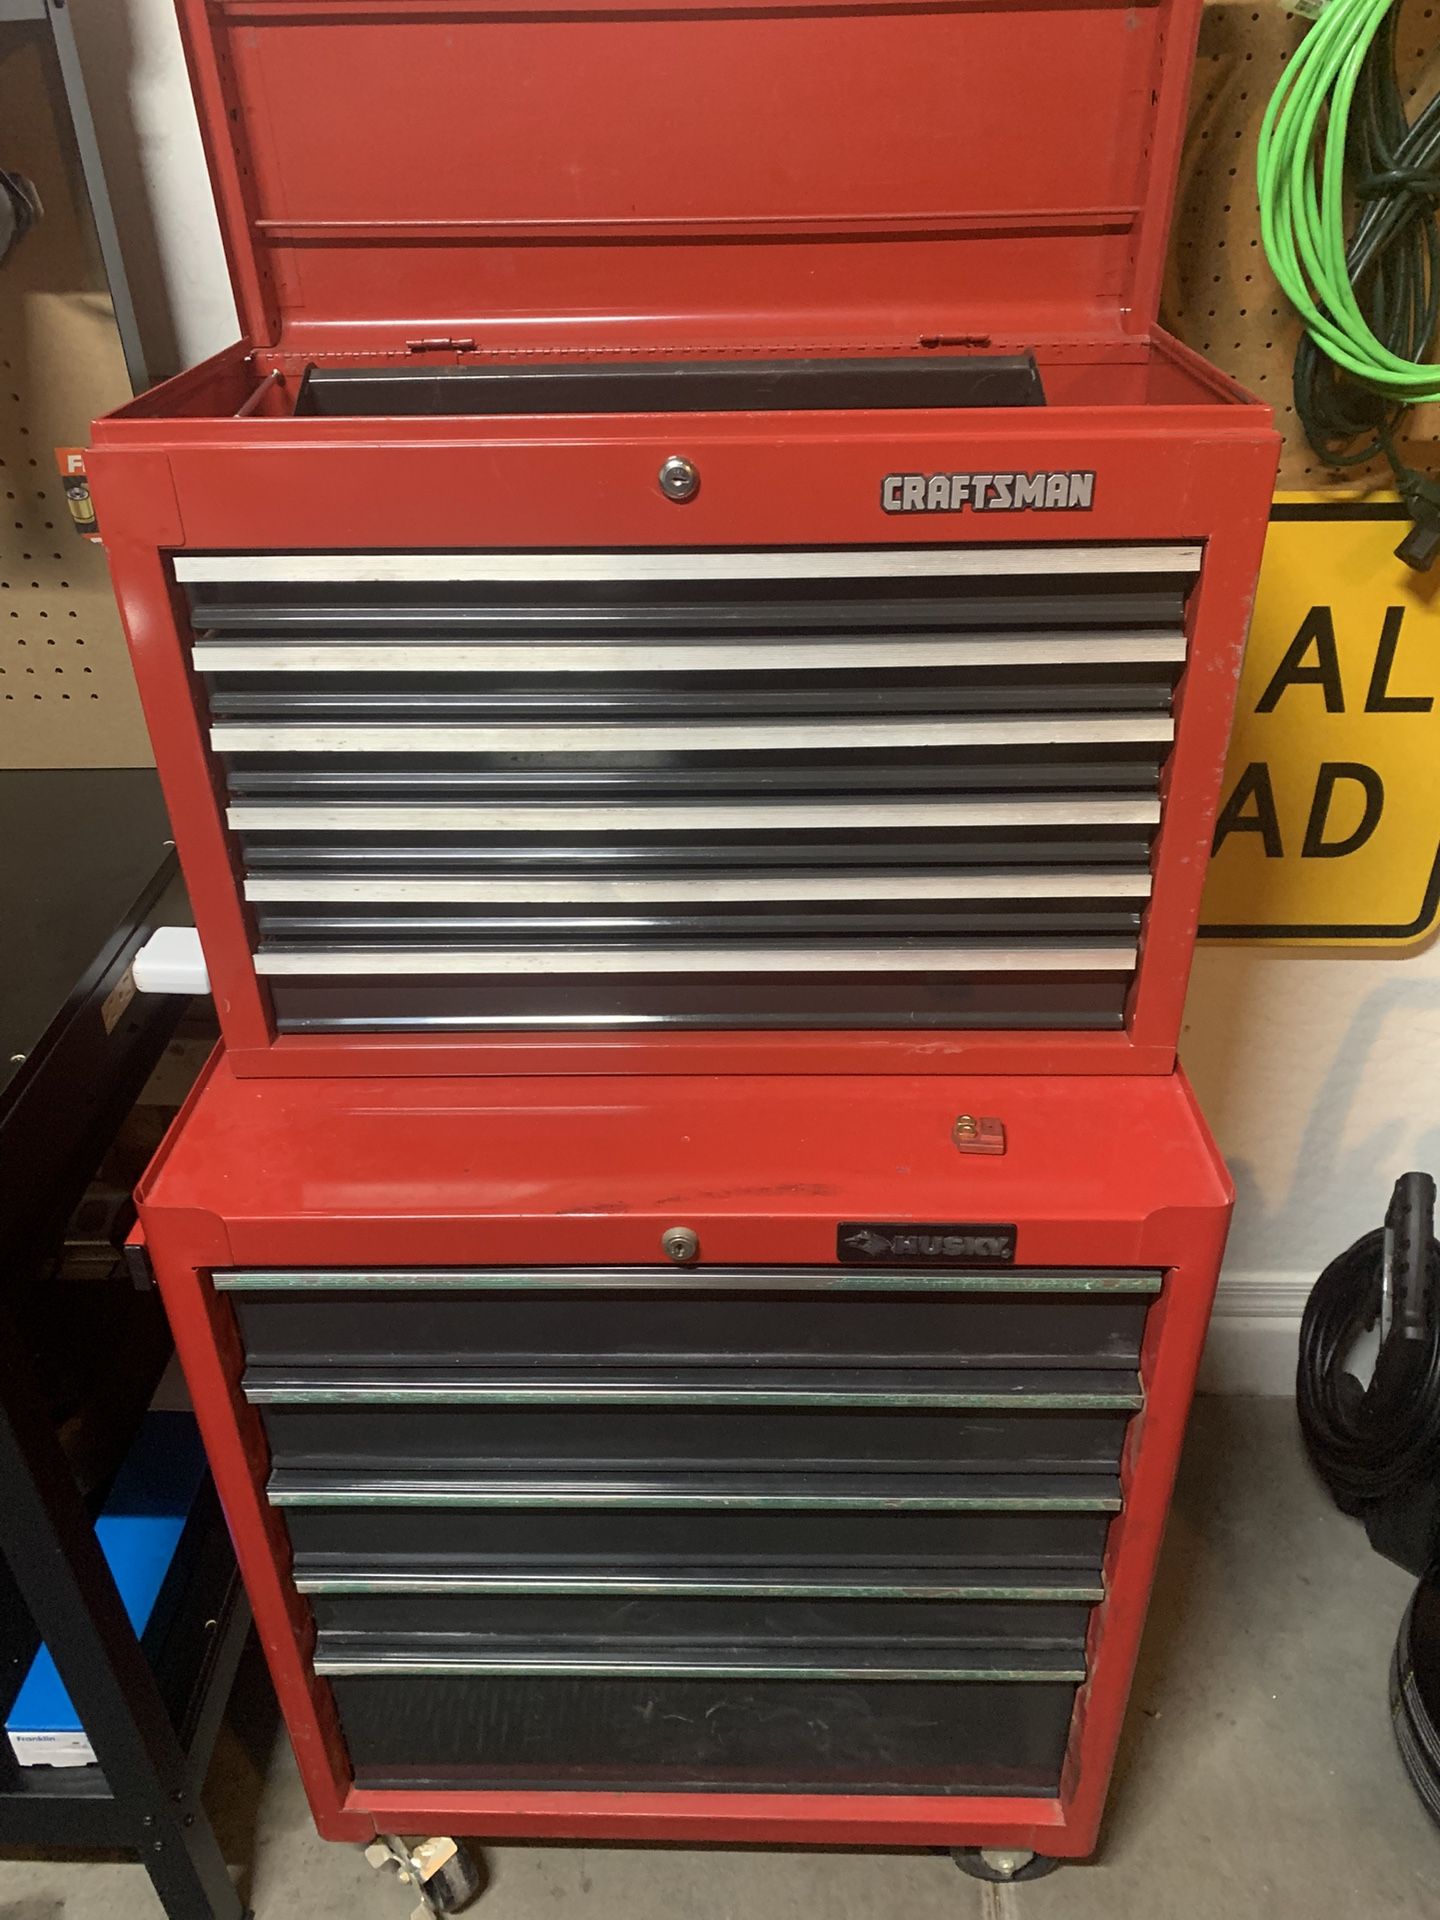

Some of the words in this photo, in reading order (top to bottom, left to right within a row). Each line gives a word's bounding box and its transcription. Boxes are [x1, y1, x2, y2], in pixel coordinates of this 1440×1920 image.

[883, 473, 1094, 511] CRAFTSMAN
[1254, 606, 1434, 713] AL
[894, 1235, 1010, 1257] HUSKY
